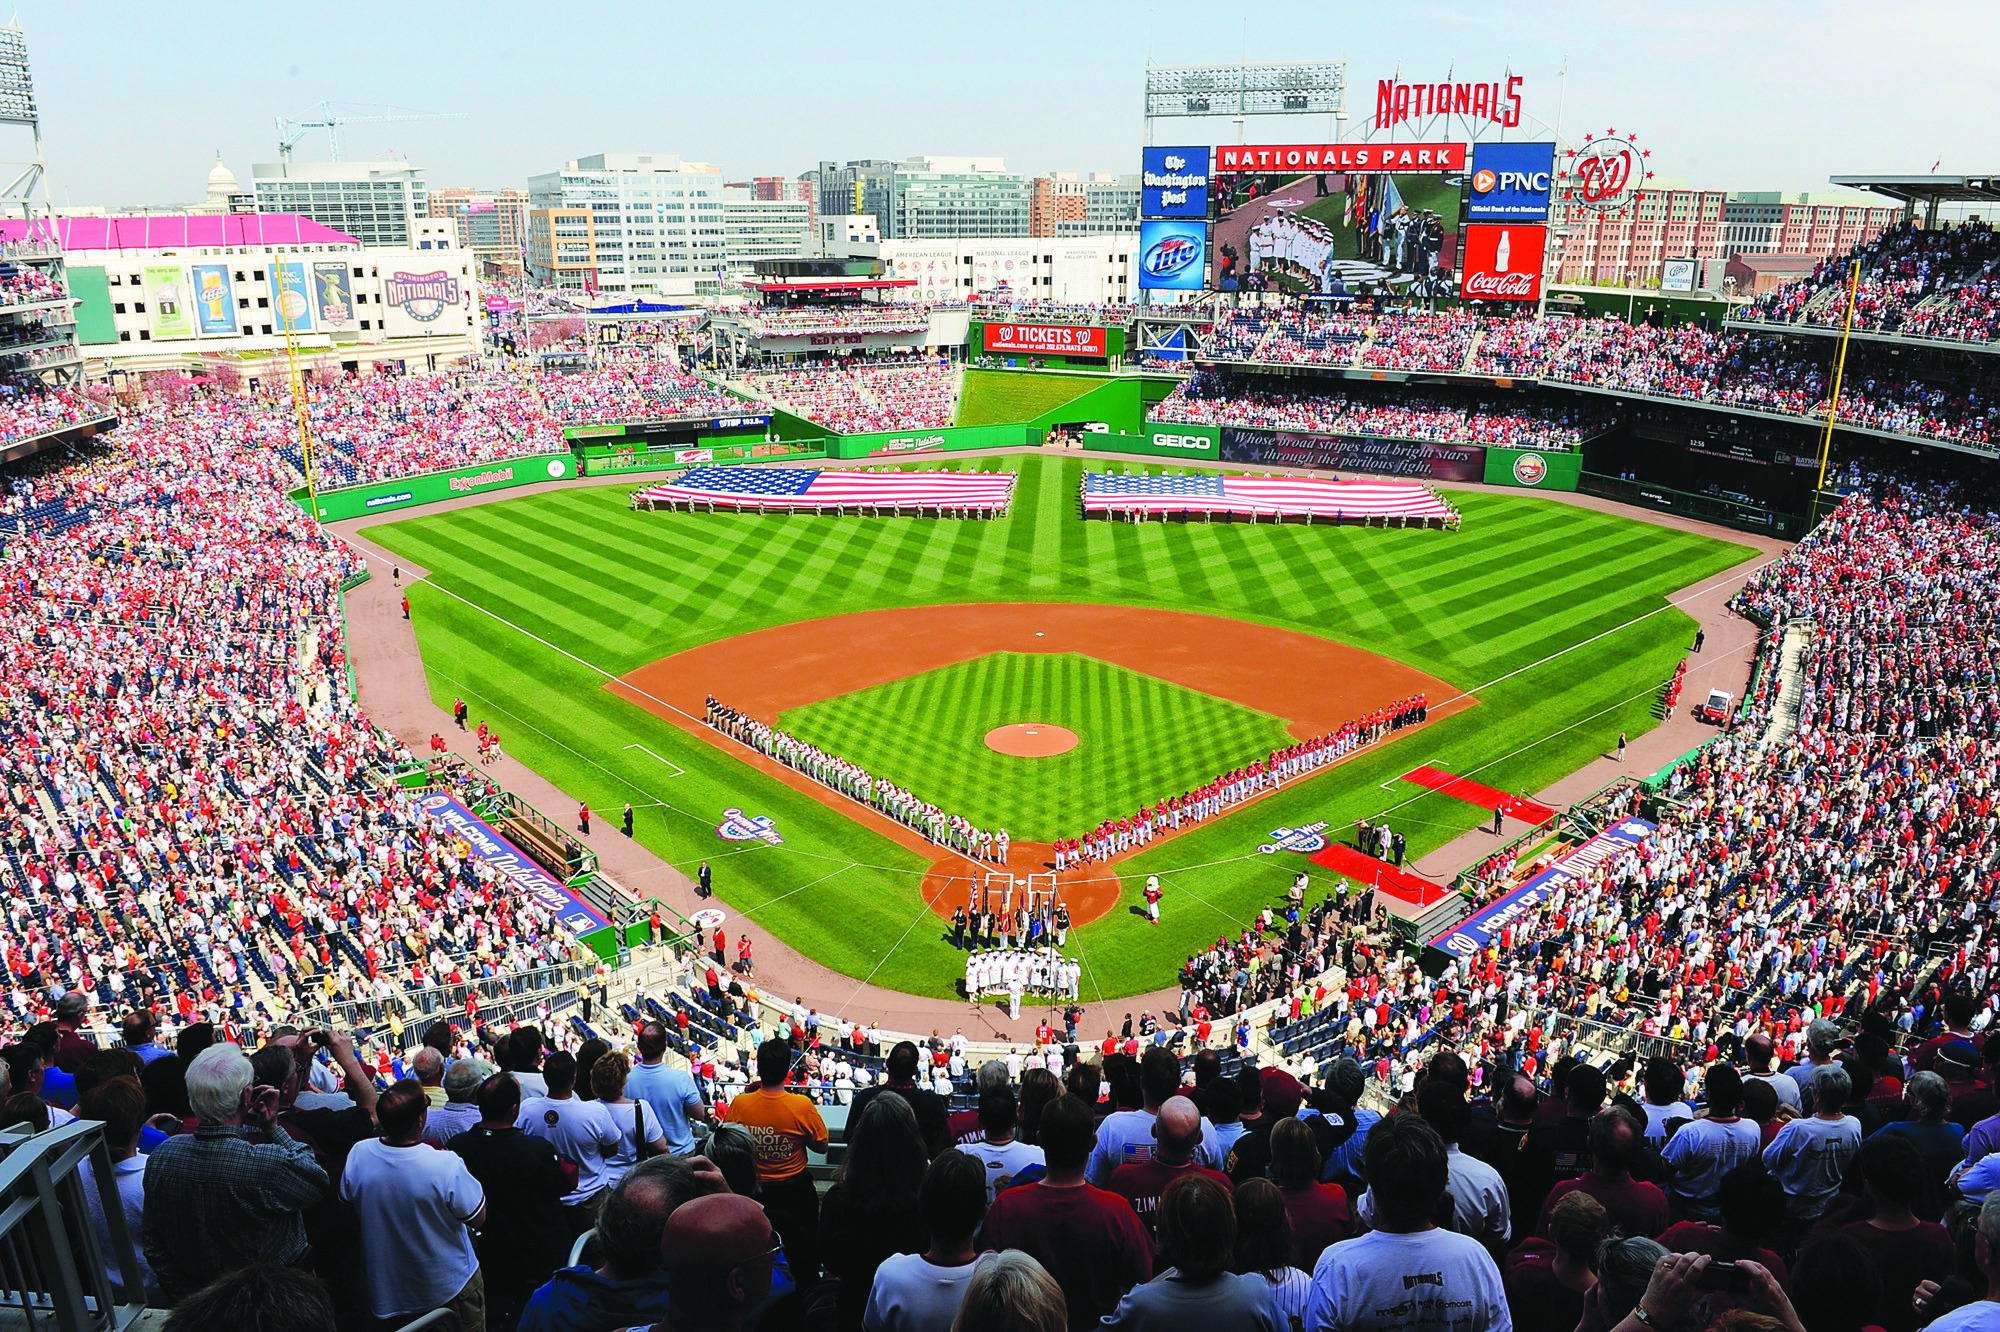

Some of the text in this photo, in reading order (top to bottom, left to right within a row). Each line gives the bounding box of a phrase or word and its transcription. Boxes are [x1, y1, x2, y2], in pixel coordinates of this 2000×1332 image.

[1376, 76, 1523, 129] NATIONALS
[1164, 155, 1186, 171] The
[1224, 149, 1451, 166] NATIONALS PARK
[1144, 171, 1206, 190] Washington
[1499, 171, 1549, 191] PNC
[1161, 190, 1187, 208] Post
[1491, 205, 1504, 213] Bank
[1150, 245, 1195, 273] Lite
[396, 272, 445, 283] WASHINGTON
[386, 279, 458, 306] NATIONALS
[810, 336, 830, 345] RED
[1016, 326, 1072, 344] TICKETS
[992, 341, 1028, 349] nationals.com
[1152, 433, 1211, 450] GEICO
[1234, 431, 1470, 462] Whose broad stripes and bright stars
[1263, 447, 1314, 465] through
[1317, 452, 1338, 465] the
[1338, 454, 1394, 471] perilous
[449, 467, 514, 491] ExxonMobil
[440, 808, 502, 856] WELCOME
[1476, 902, 1528, 935] HOME
[1517, 889, 1543, 907] OF
[1535, 872, 1573, 895] THE
[1135, 1196, 1161, 1213] ZIM
[1402, 1271, 1444, 1290] NATIONALS
